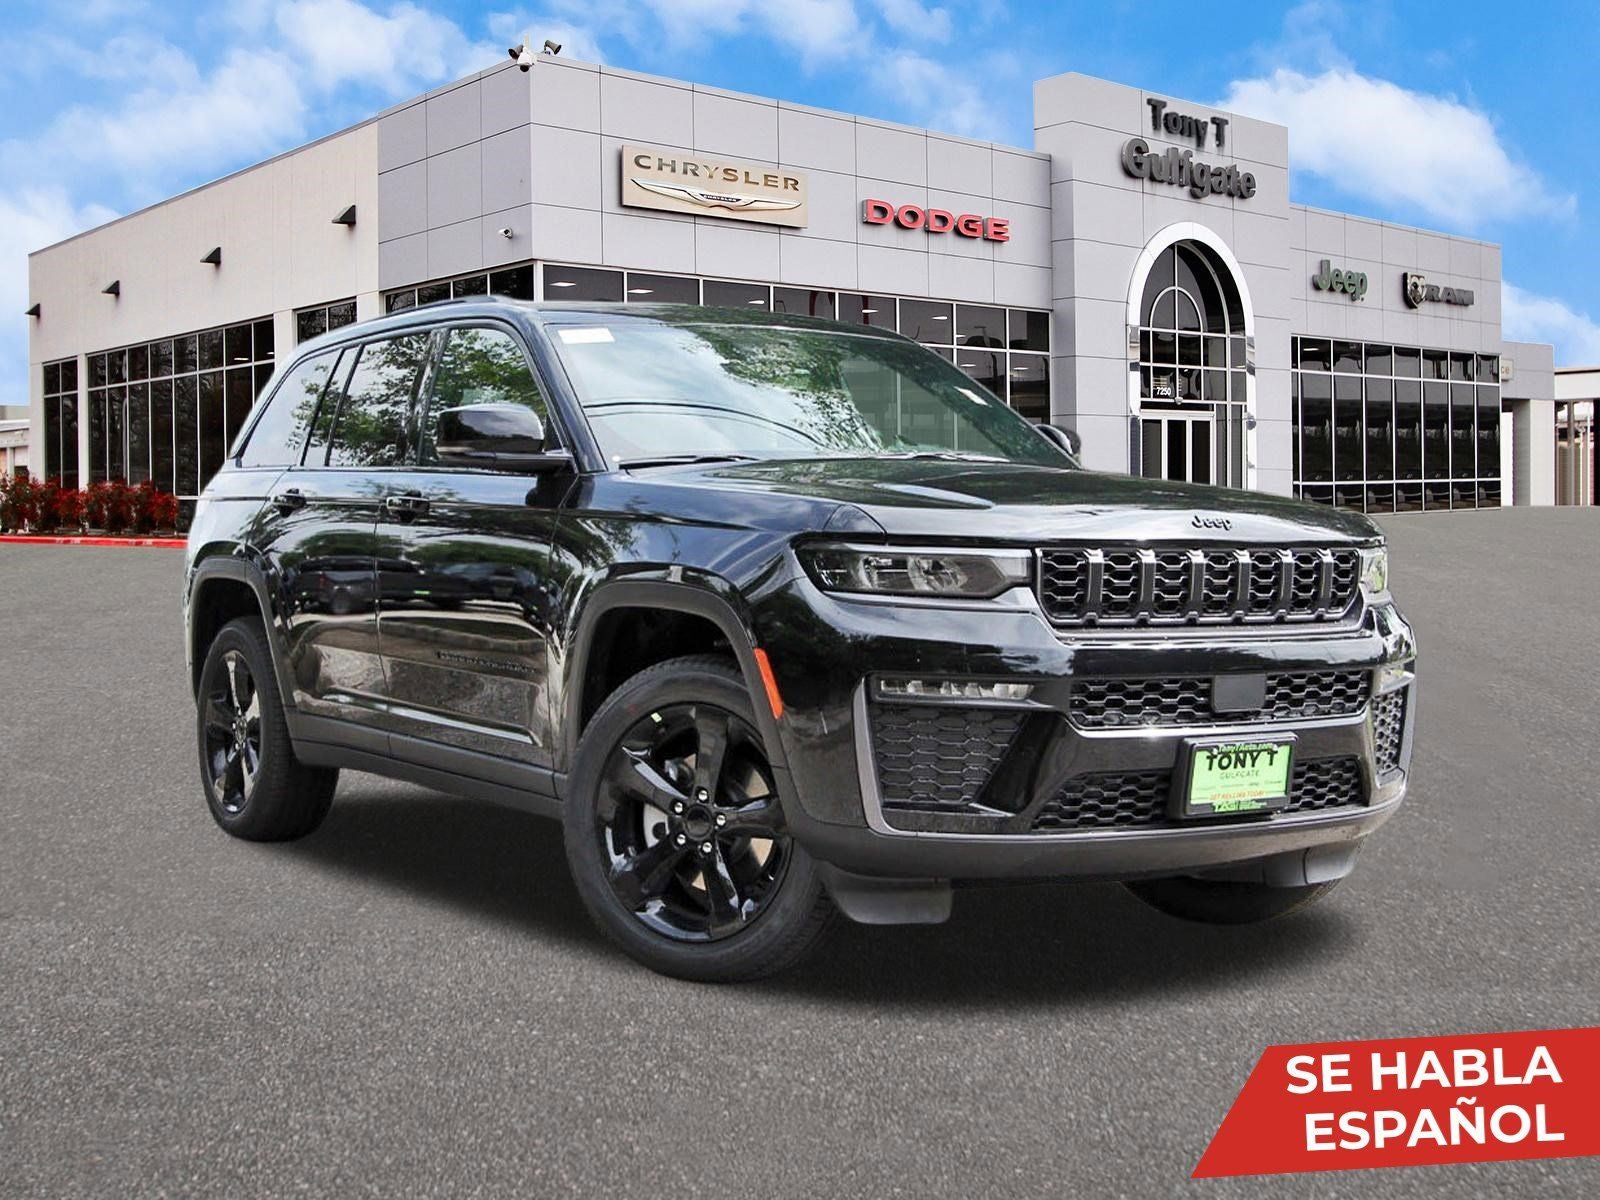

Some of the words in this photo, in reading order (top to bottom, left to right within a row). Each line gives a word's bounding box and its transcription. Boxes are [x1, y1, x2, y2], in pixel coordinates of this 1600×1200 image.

[1147, 98, 1208, 148] Tony
[1210, 116, 1229, 148] T
[633, 154, 801, 192] CHRYSLER
[1120, 137, 1257, 199] Gulfgate
[862, 198, 1010, 242] DODGE
[1312, 259, 1368, 302] Jeep
[1425, 284, 1474, 306] RAM
[1156, 386, 1172, 396] 7250
[1191, 514, 1232, 532] Jeep
[1206, 749, 1261, 771] TONY
[1267, 750, 1278, 766] T
